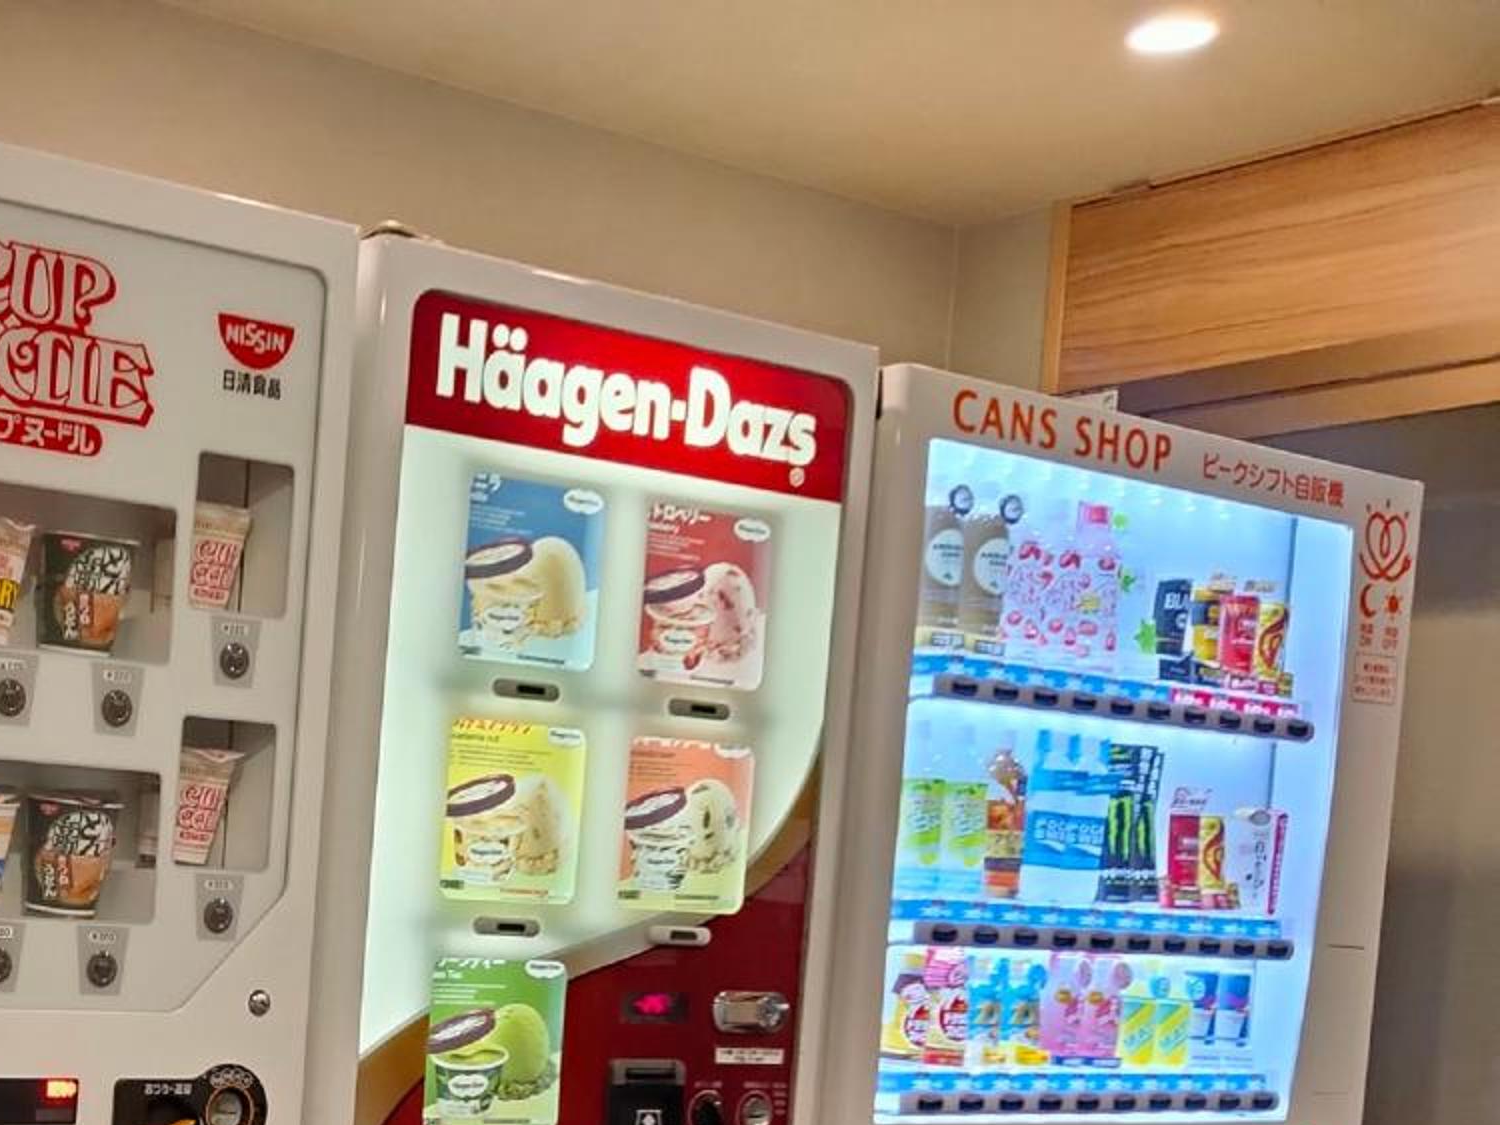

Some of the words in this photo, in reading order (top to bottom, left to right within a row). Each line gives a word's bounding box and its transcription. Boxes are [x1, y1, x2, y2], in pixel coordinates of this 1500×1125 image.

[225, 322, 286, 355] NISSIN
[223, 369, 281, 401] 日清食品
[435, 312, 817, 467] Häagen-Dazs
[952, 388, 1058, 450] CANS
[1074, 416, 1172, 473] SHOP
[1203, 452, 1345, 509] ピークシフト自販機
